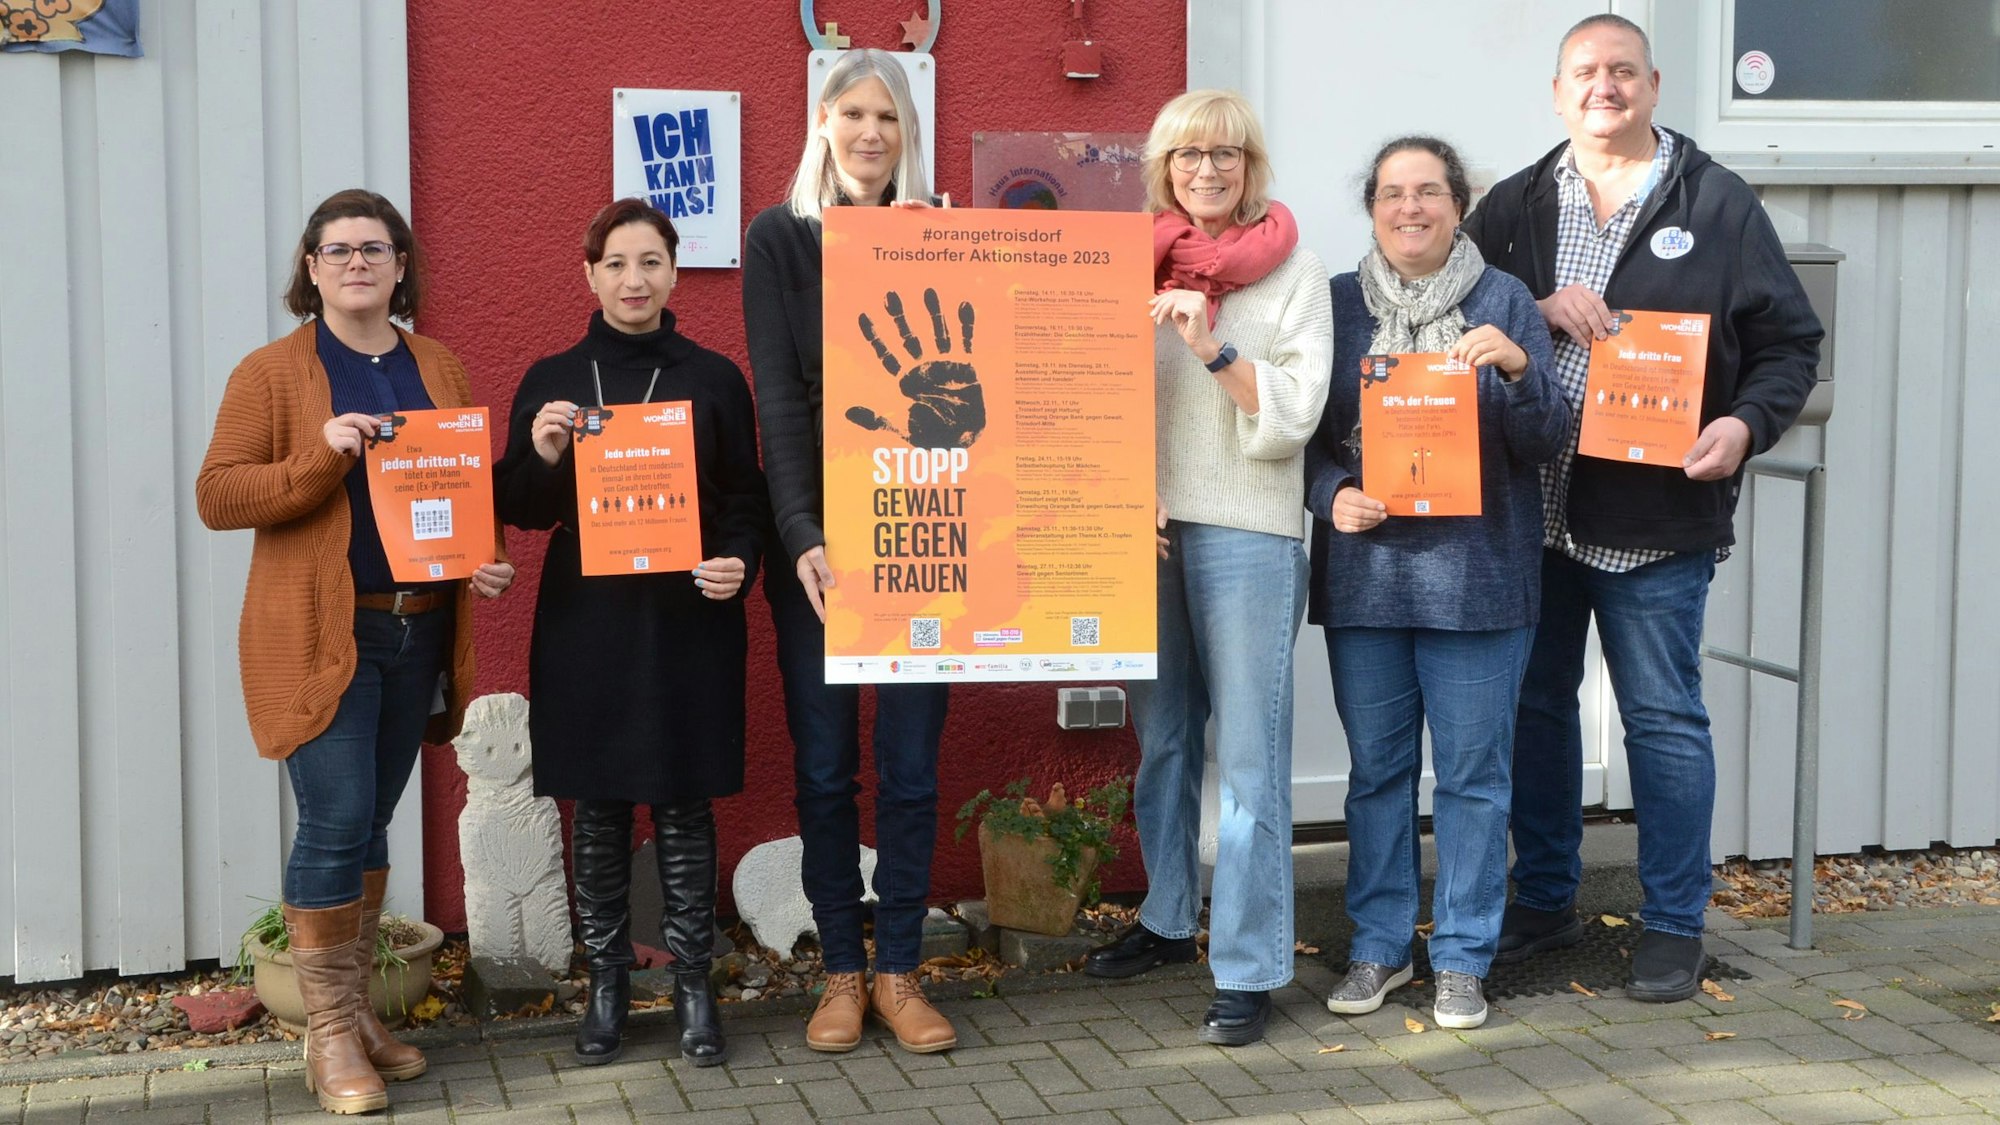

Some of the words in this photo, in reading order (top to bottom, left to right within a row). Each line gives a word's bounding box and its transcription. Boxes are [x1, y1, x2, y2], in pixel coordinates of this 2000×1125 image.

[632, 108, 711, 162] ICH
[644, 155, 715, 191] KANN
[989, 174, 1010, 197] Haus
[1010, 167, 1068, 197] International
[650, 186, 715, 219] WAS!
[923, 227, 1062, 245] #orangetroisdorf
[873, 247, 965, 264] Troisdorfer
[970, 249, 1068, 267] Aktionstage
[1073, 250, 1110, 265] 2023
[1660, 323, 1691, 331] WOMEN
[1618, 350, 1636, 360] Jede
[1638, 351, 1661, 361] dritte
[1663, 352, 1682, 363] Frau
[1382, 396, 1405, 407] 58%
[1407, 396, 1422, 406] der
[1424, 395, 1456, 406] Frauen
[437, 421, 471, 429] WOMEN
[643, 415, 674, 423] WOMEN
[406, 445, 422, 453] Etwa
[605, 449, 624, 459] Jede
[625, 447, 650, 458] dritte
[652, 446, 671, 456] Frau
[381, 457, 413, 473] jeden
[416, 455, 457, 469] dritten
[459, 453, 481, 468] Tag
[598, 463, 637, 473] Deutschland
[639, 462, 647, 471] ist
[648, 461, 684, 470] mindestens
[872, 447, 969, 485] STOPP
[404, 471, 423, 480] tötet
[425, 470, 438, 478] ein
[440, 469, 461, 478] Mann
[602, 474, 624, 482] einmal
[633, 473, 652, 481] ihrem
[653, 472, 672, 480] Leben
[394, 483, 415, 493] seine
[416, 480, 472, 493] (Ex-)Partnerin.
[604, 485, 615, 493] von
[616, 484, 639, 493] Gewalt
[873, 488, 967, 517] GEWALT
[873, 521, 968, 558] GEGEN
[873, 563, 968, 593] FRAUEN
